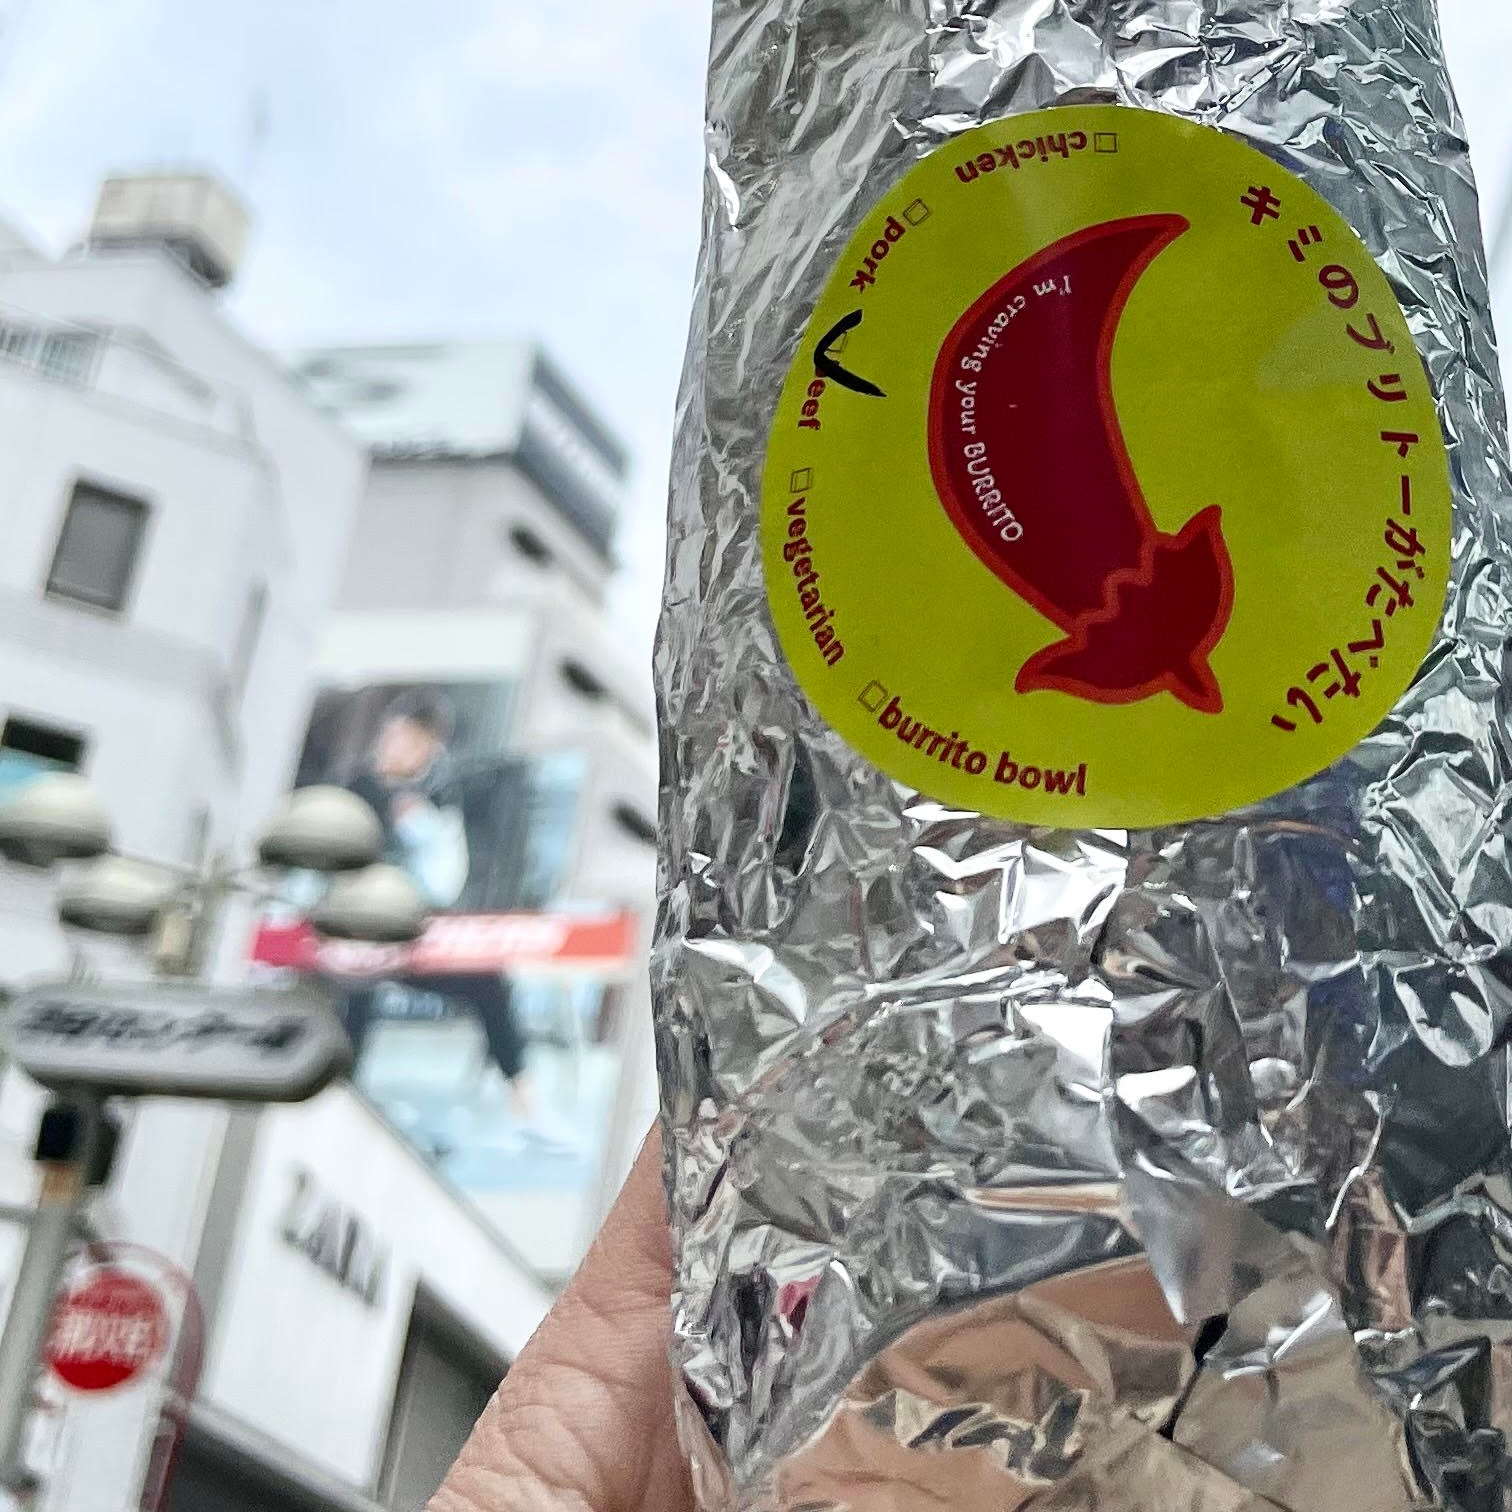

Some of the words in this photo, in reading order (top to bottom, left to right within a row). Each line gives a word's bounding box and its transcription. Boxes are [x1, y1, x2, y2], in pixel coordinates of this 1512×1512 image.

[954, 130, 1088, 184] chicken
[849, 214, 907, 295] pork
[1033, 274, 1072, 297] I'm
[960, 295, 1027, 373] craving
[955, 378, 978, 435] your
[963, 441, 1025, 542] BURRITO
[783, 496, 846, 667] vegetarian
[878, 694, 988, 776] burrito
[994, 750, 1089, 797] bowl
